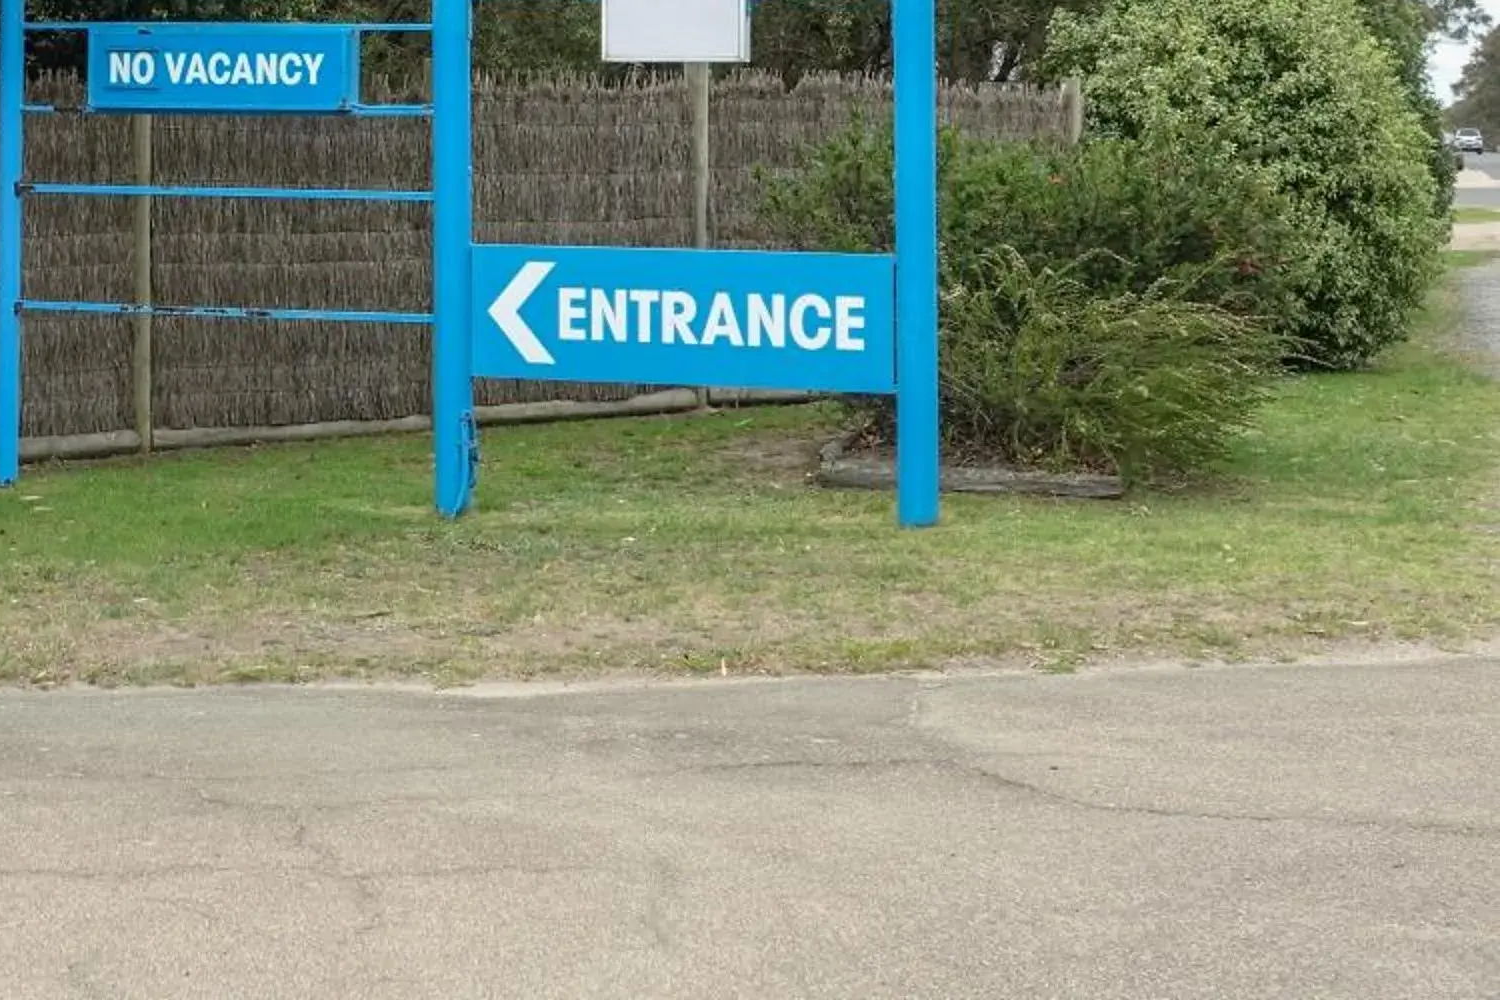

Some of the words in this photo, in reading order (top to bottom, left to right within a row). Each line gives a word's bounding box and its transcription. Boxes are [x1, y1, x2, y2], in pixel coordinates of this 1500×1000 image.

[109, 52, 155, 85] NO
[165, 52, 325, 86] VACANCY
[557, 286, 866, 352] ENTRANCE
